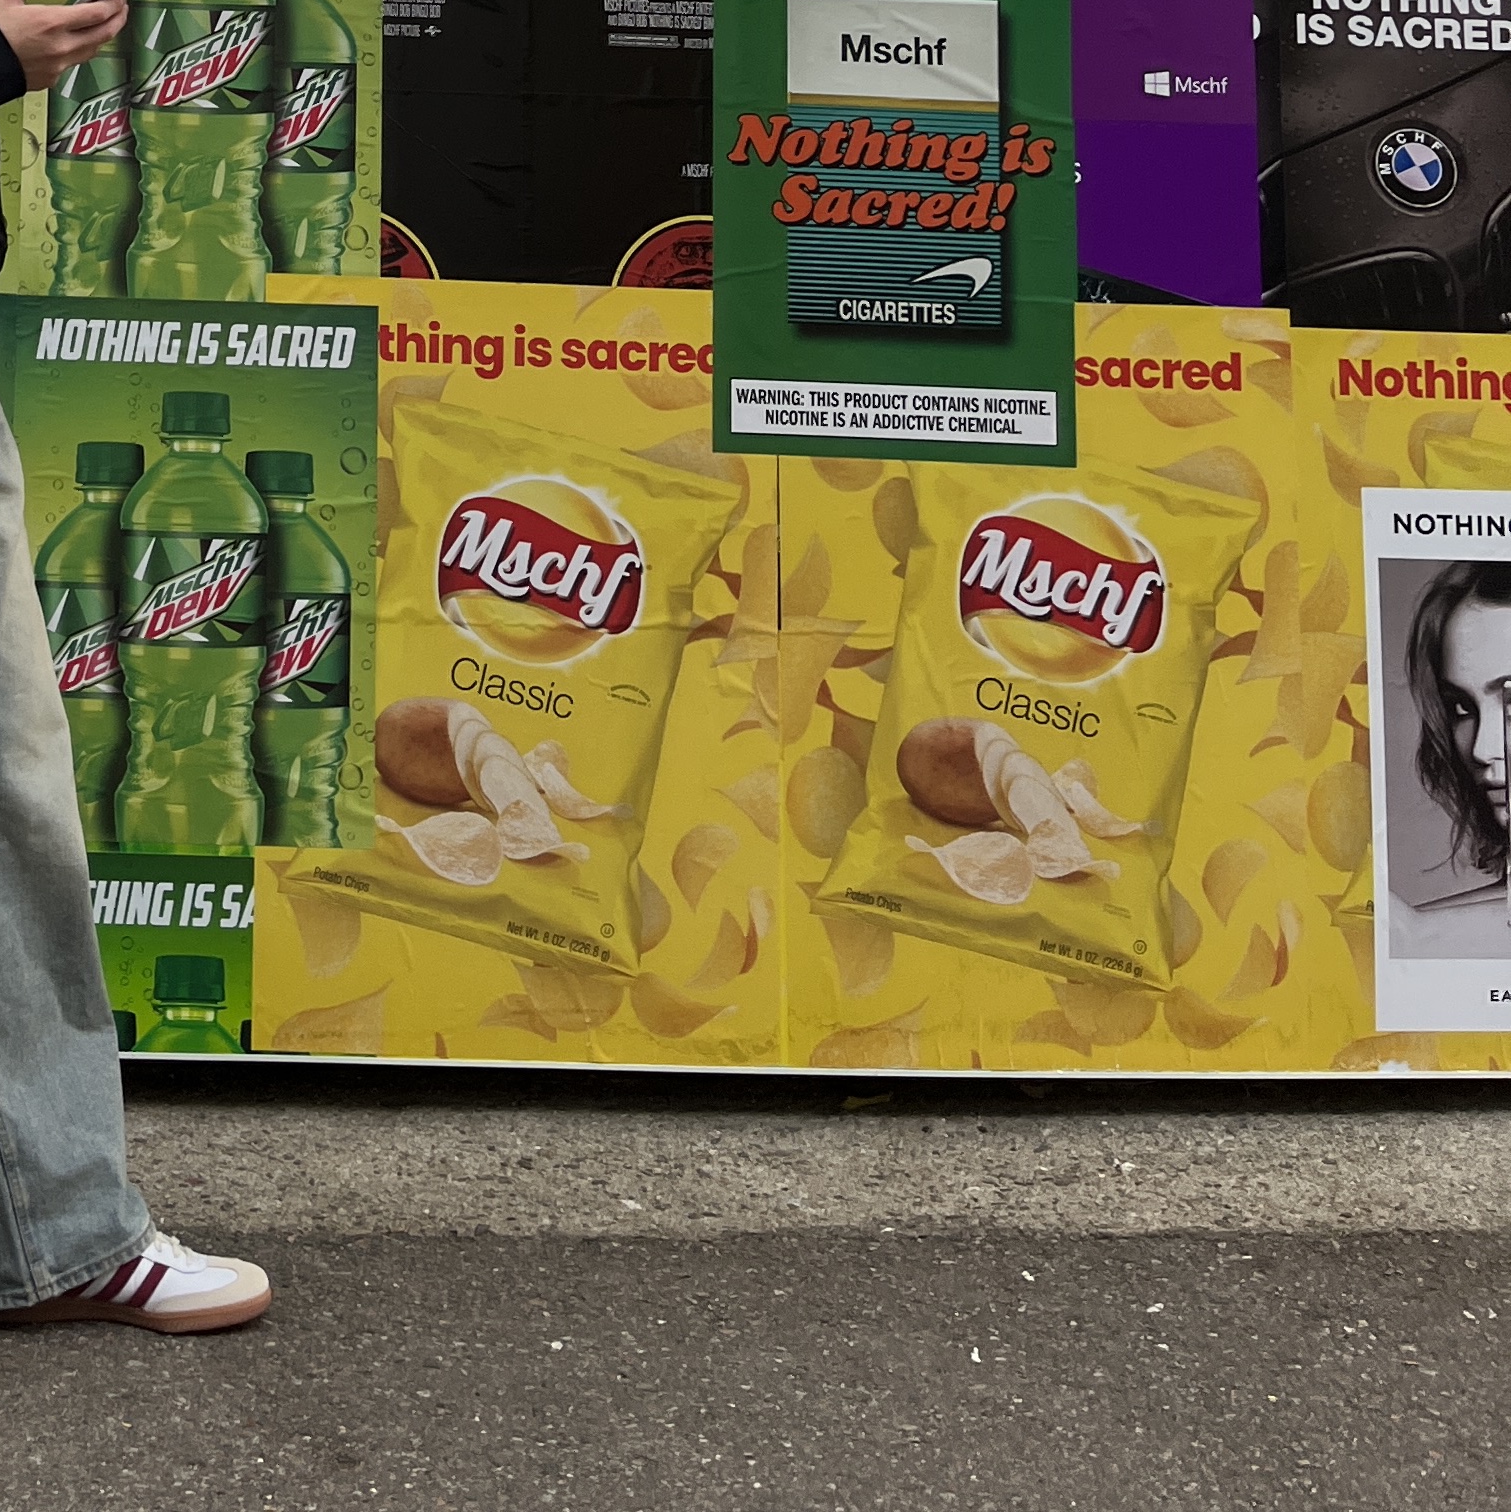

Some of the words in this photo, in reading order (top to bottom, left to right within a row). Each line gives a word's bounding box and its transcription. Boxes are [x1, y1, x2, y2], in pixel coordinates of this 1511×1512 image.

[841, 33, 947, 66] Mschf
[1296, 13, 1335, 45] IS
[1348, 15, 1511, 52] SACRED
[1175, 75, 1228, 95] Mschf
[727, 113, 988, 182] Nothing
[1000, 123, 1056, 175] is
[1379, 132, 1443, 175] MSCHF
[771, 173, 1017, 232] Sacred!
[838, 298, 956, 325] CIGARETTES
[36, 317, 182, 364] NOTHING
[186, 322, 221, 365] IS
[225, 324, 357, 370] SACRED
[514, 324, 550, 369] is
[1074, 352, 1243, 392] sacred
[736, 388, 805, 406] WARNING:
[809, 391, 839, 407] THIS
[844, 392, 908, 410] PRODUCT
[913, 395, 979, 412] CONTAINS
[984, 397, 1050, 416] NICOTINE.
[765, 409, 828, 427] NICOTINE
[833, 412, 845, 427] IS
[850, 412, 868, 428] AN
[873, 413, 944, 431] ADDICTIVE
[949, 417, 1022, 434] CHEMICAL.
[1393, 513, 1511, 537] NOTHIN
[441, 509, 643, 626] Mschf
[961, 529, 1163, 645] Mschf
[450, 658, 575, 720] Classic
[975, 677, 1102, 739] Classic
[313, 866, 342, 884] Potato
[345, 875, 370, 893] Chips
[179, 883, 215, 927] IS
[507, 921, 523, 936] Net
[543, 932, 550, 944] 8
[1076, 949, 1083, 960] 8
